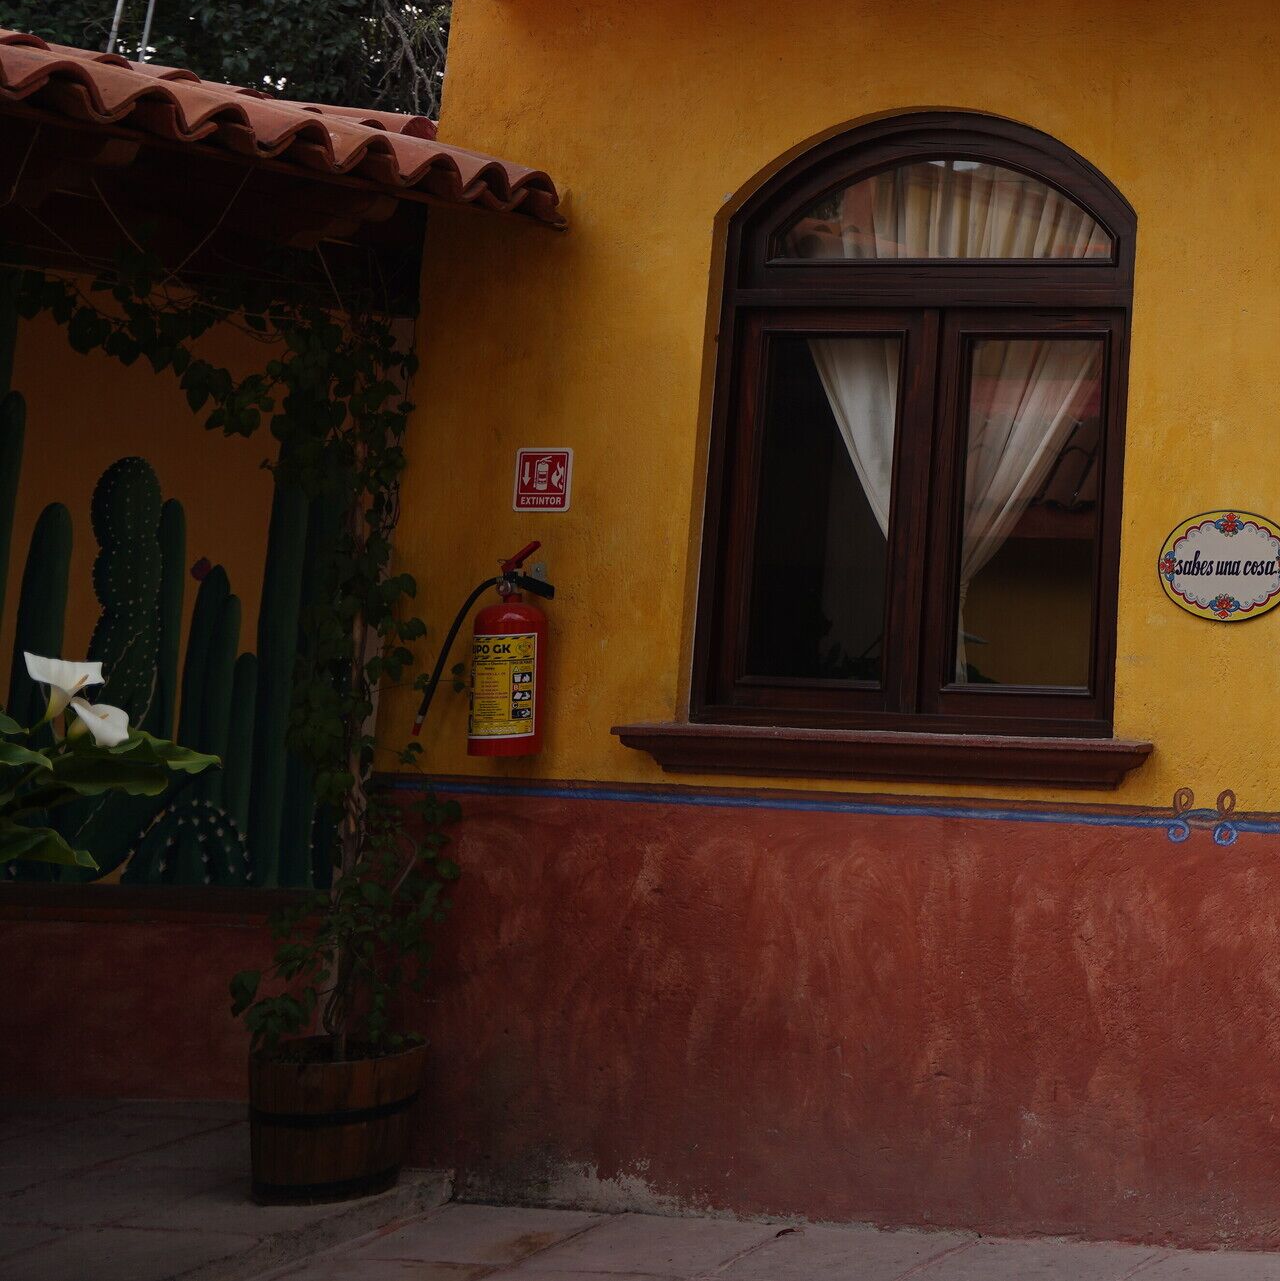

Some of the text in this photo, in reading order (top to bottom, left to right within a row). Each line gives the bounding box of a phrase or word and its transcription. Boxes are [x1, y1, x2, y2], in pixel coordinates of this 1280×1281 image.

[520, 496, 562, 505] EXTINTOR
[1174, 550, 1277, 577] sabes una cosa
[492, 643, 511, 654] GK
